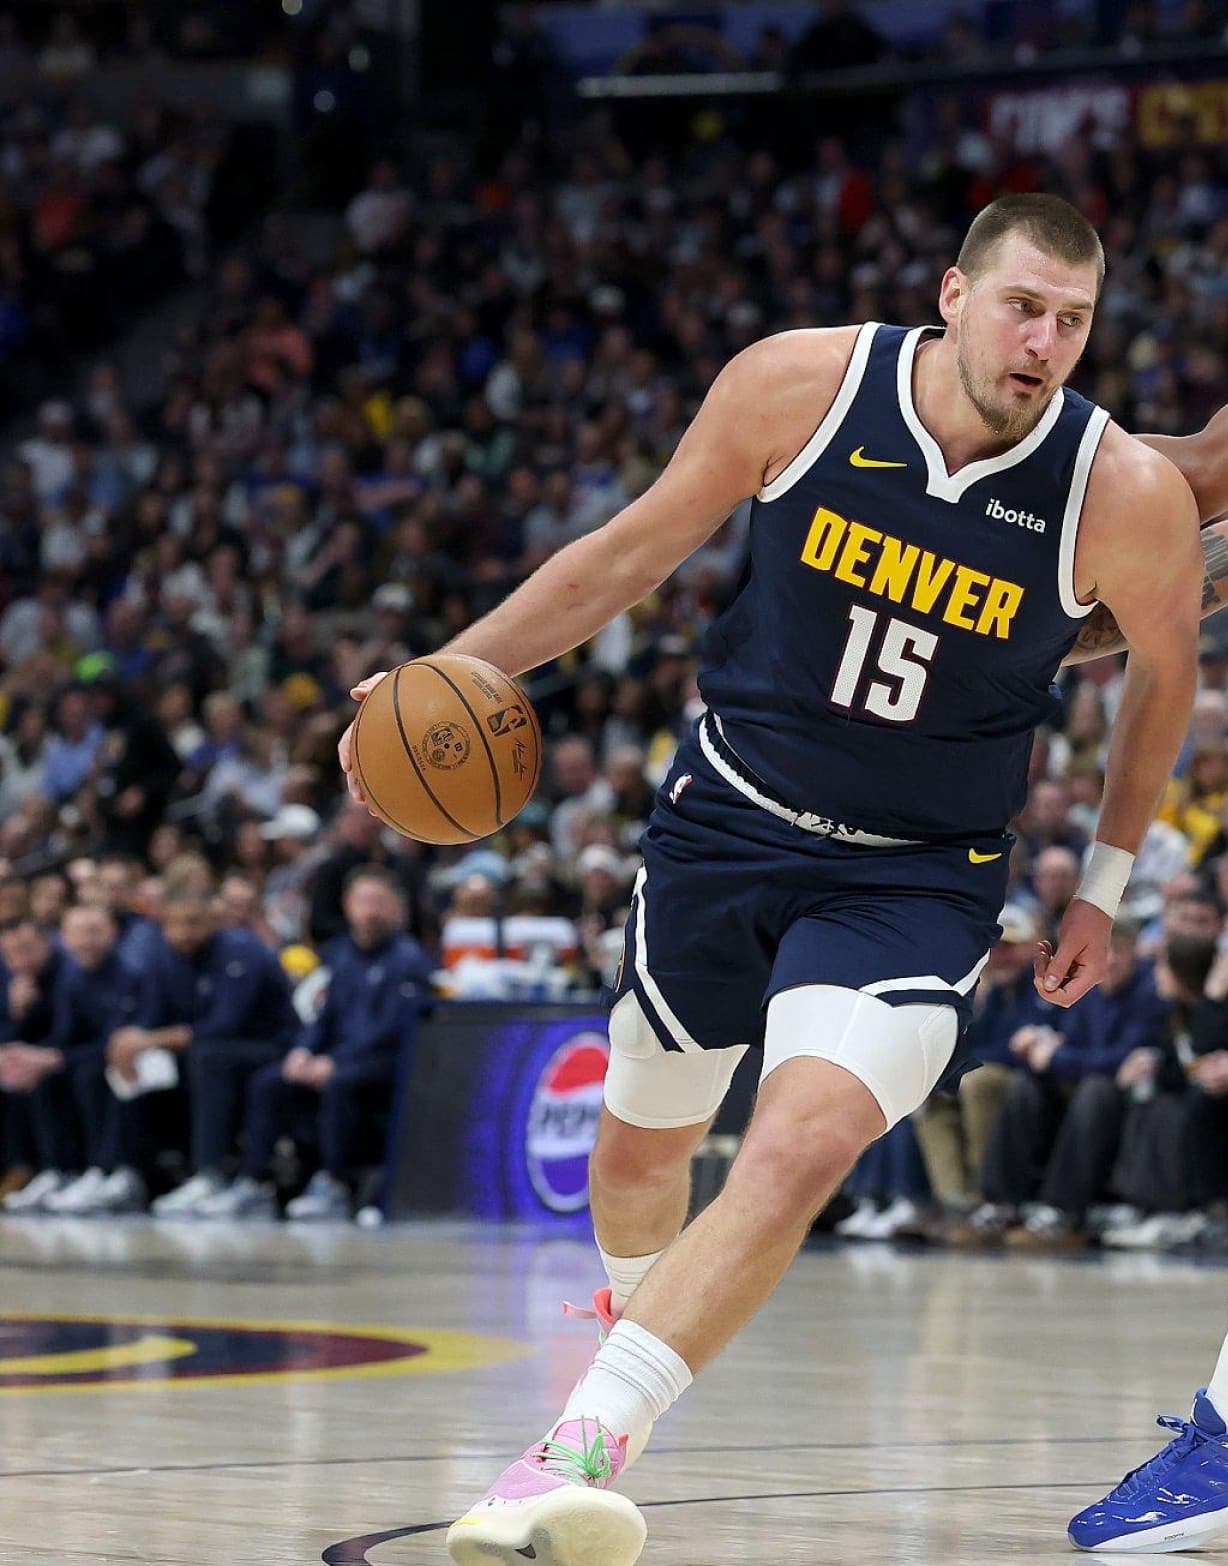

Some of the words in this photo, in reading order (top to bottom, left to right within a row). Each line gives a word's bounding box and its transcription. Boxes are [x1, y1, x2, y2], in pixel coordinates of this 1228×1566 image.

[800, 506, 1025, 640] DENVER
[984, 498, 1047, 534] ibotta
[829, 603, 940, 722] 15
